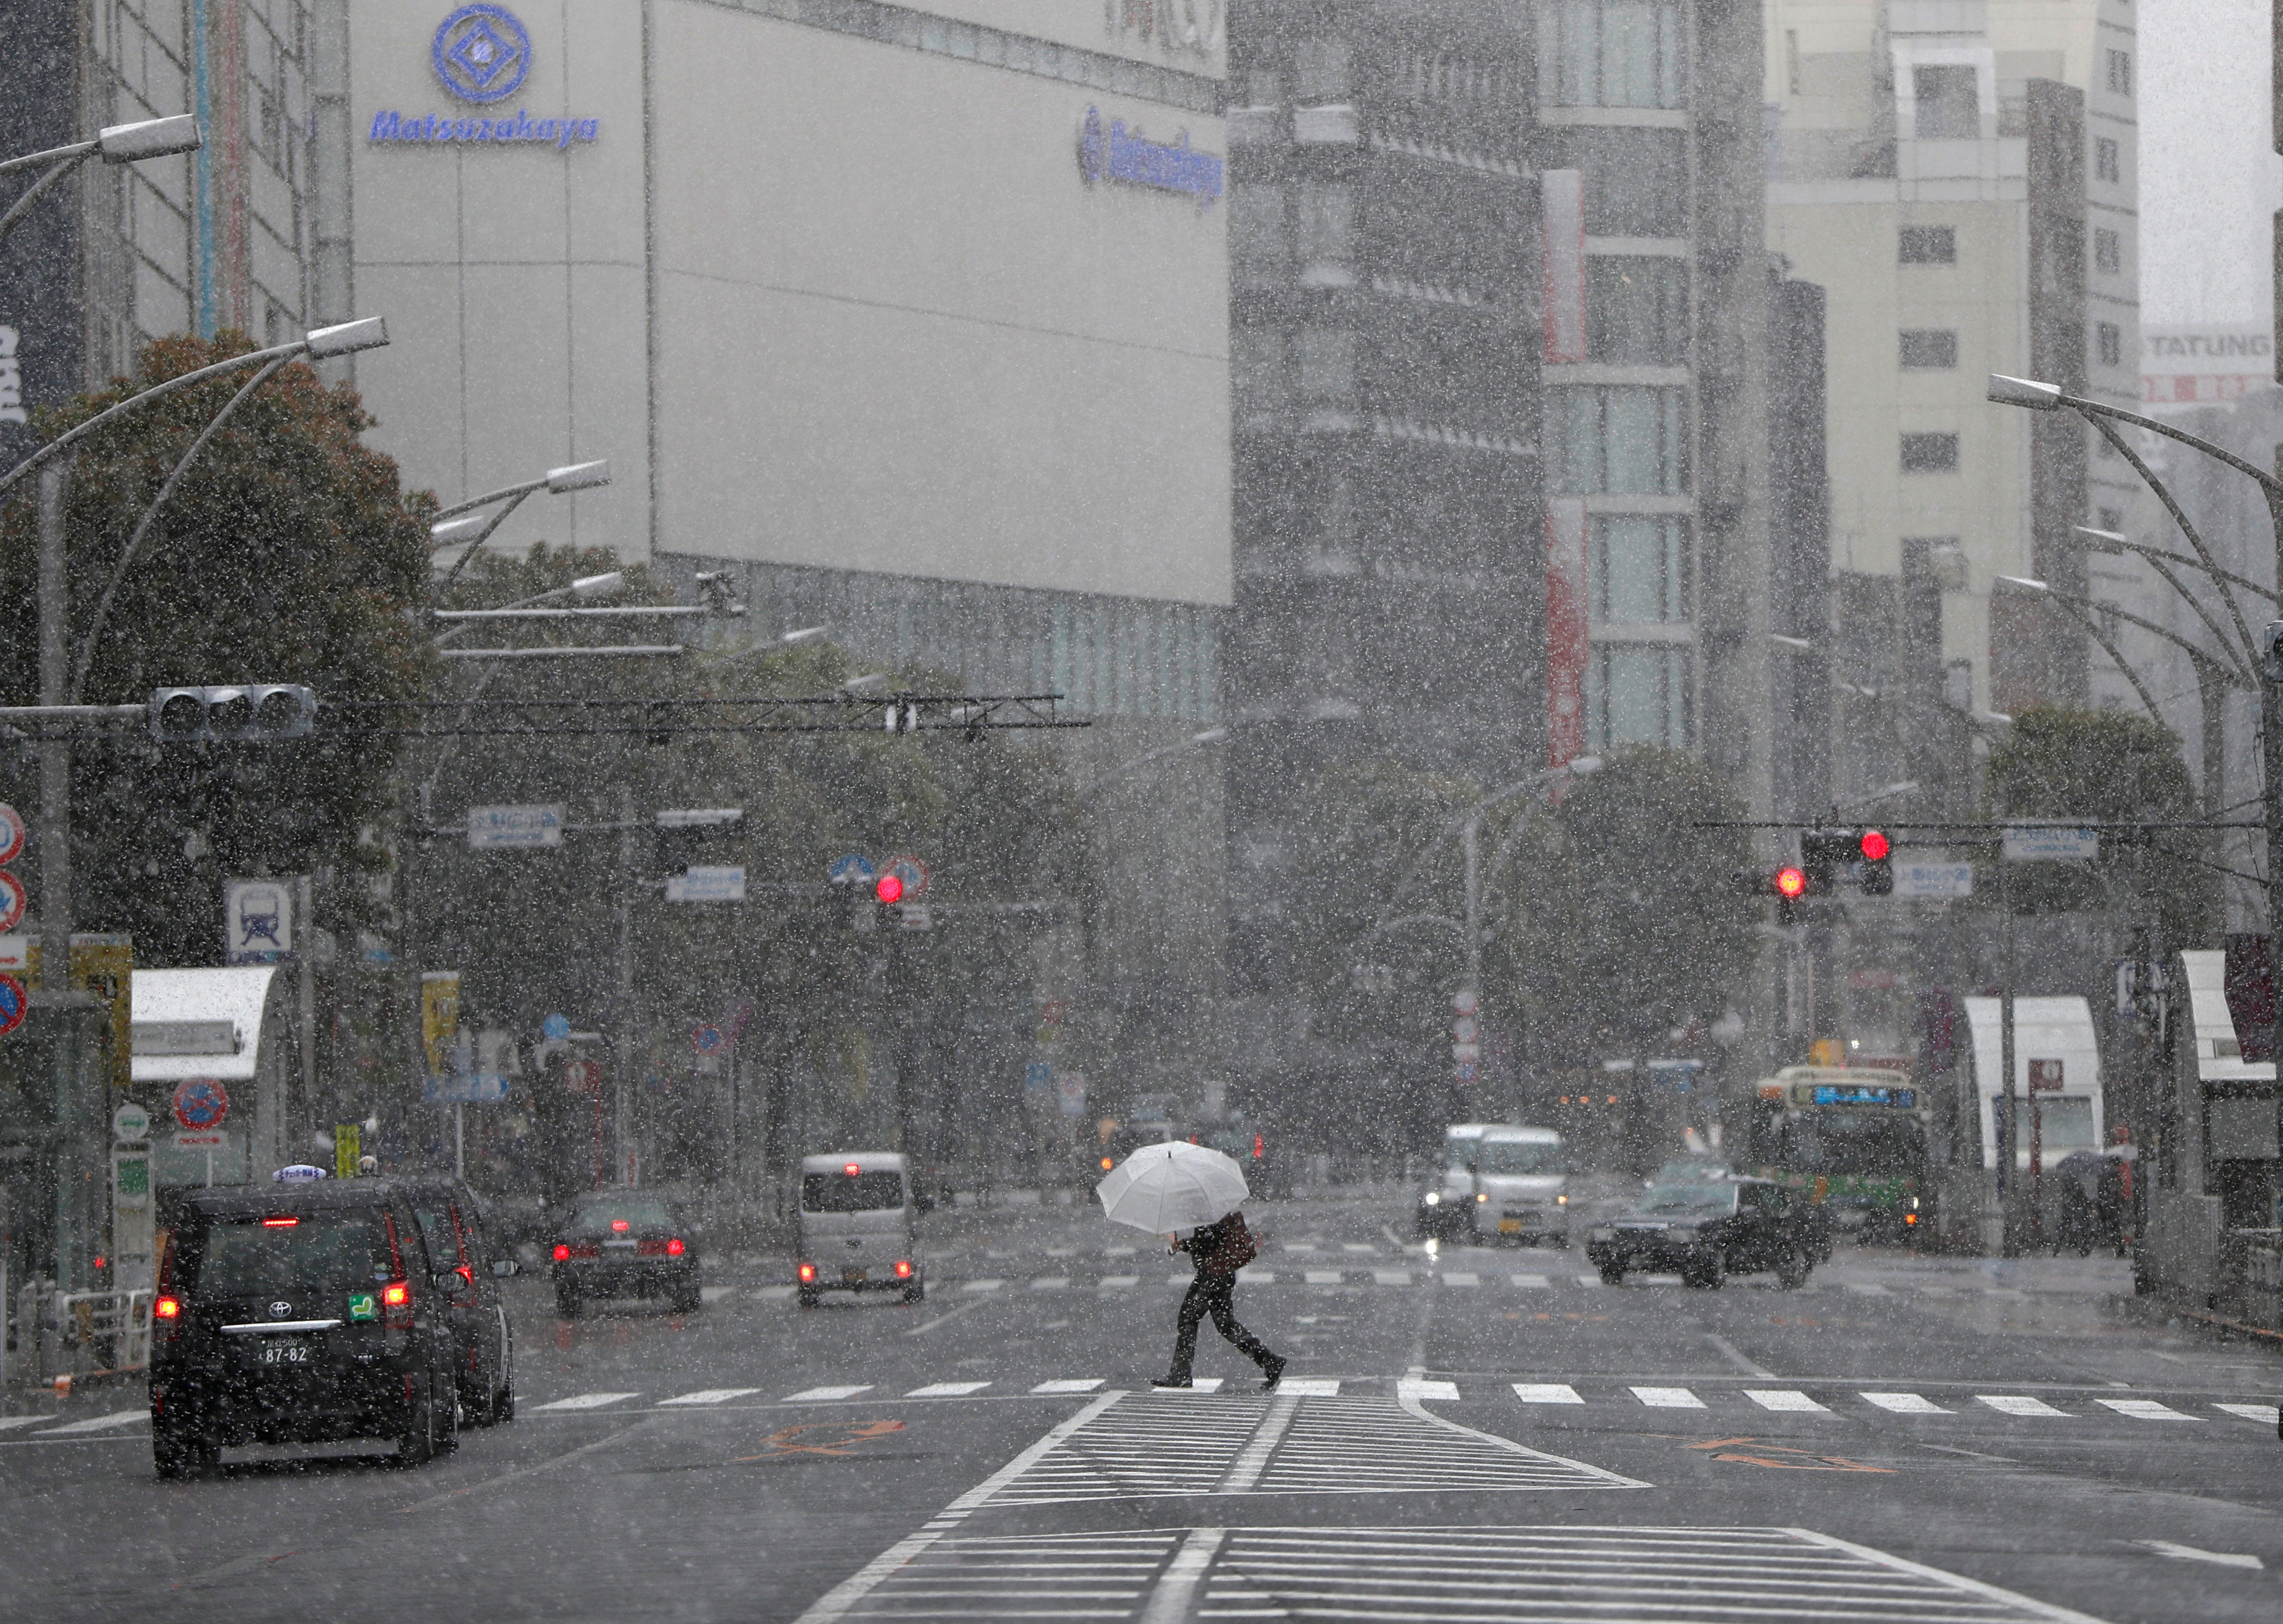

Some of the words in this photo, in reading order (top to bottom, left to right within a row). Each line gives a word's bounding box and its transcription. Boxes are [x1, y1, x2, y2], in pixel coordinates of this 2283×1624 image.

[369, 108, 599, 148] Matsuzakaya
[2147, 335, 2271, 357] TATUNG
[266, 1347, 307, 1363] 87-82
